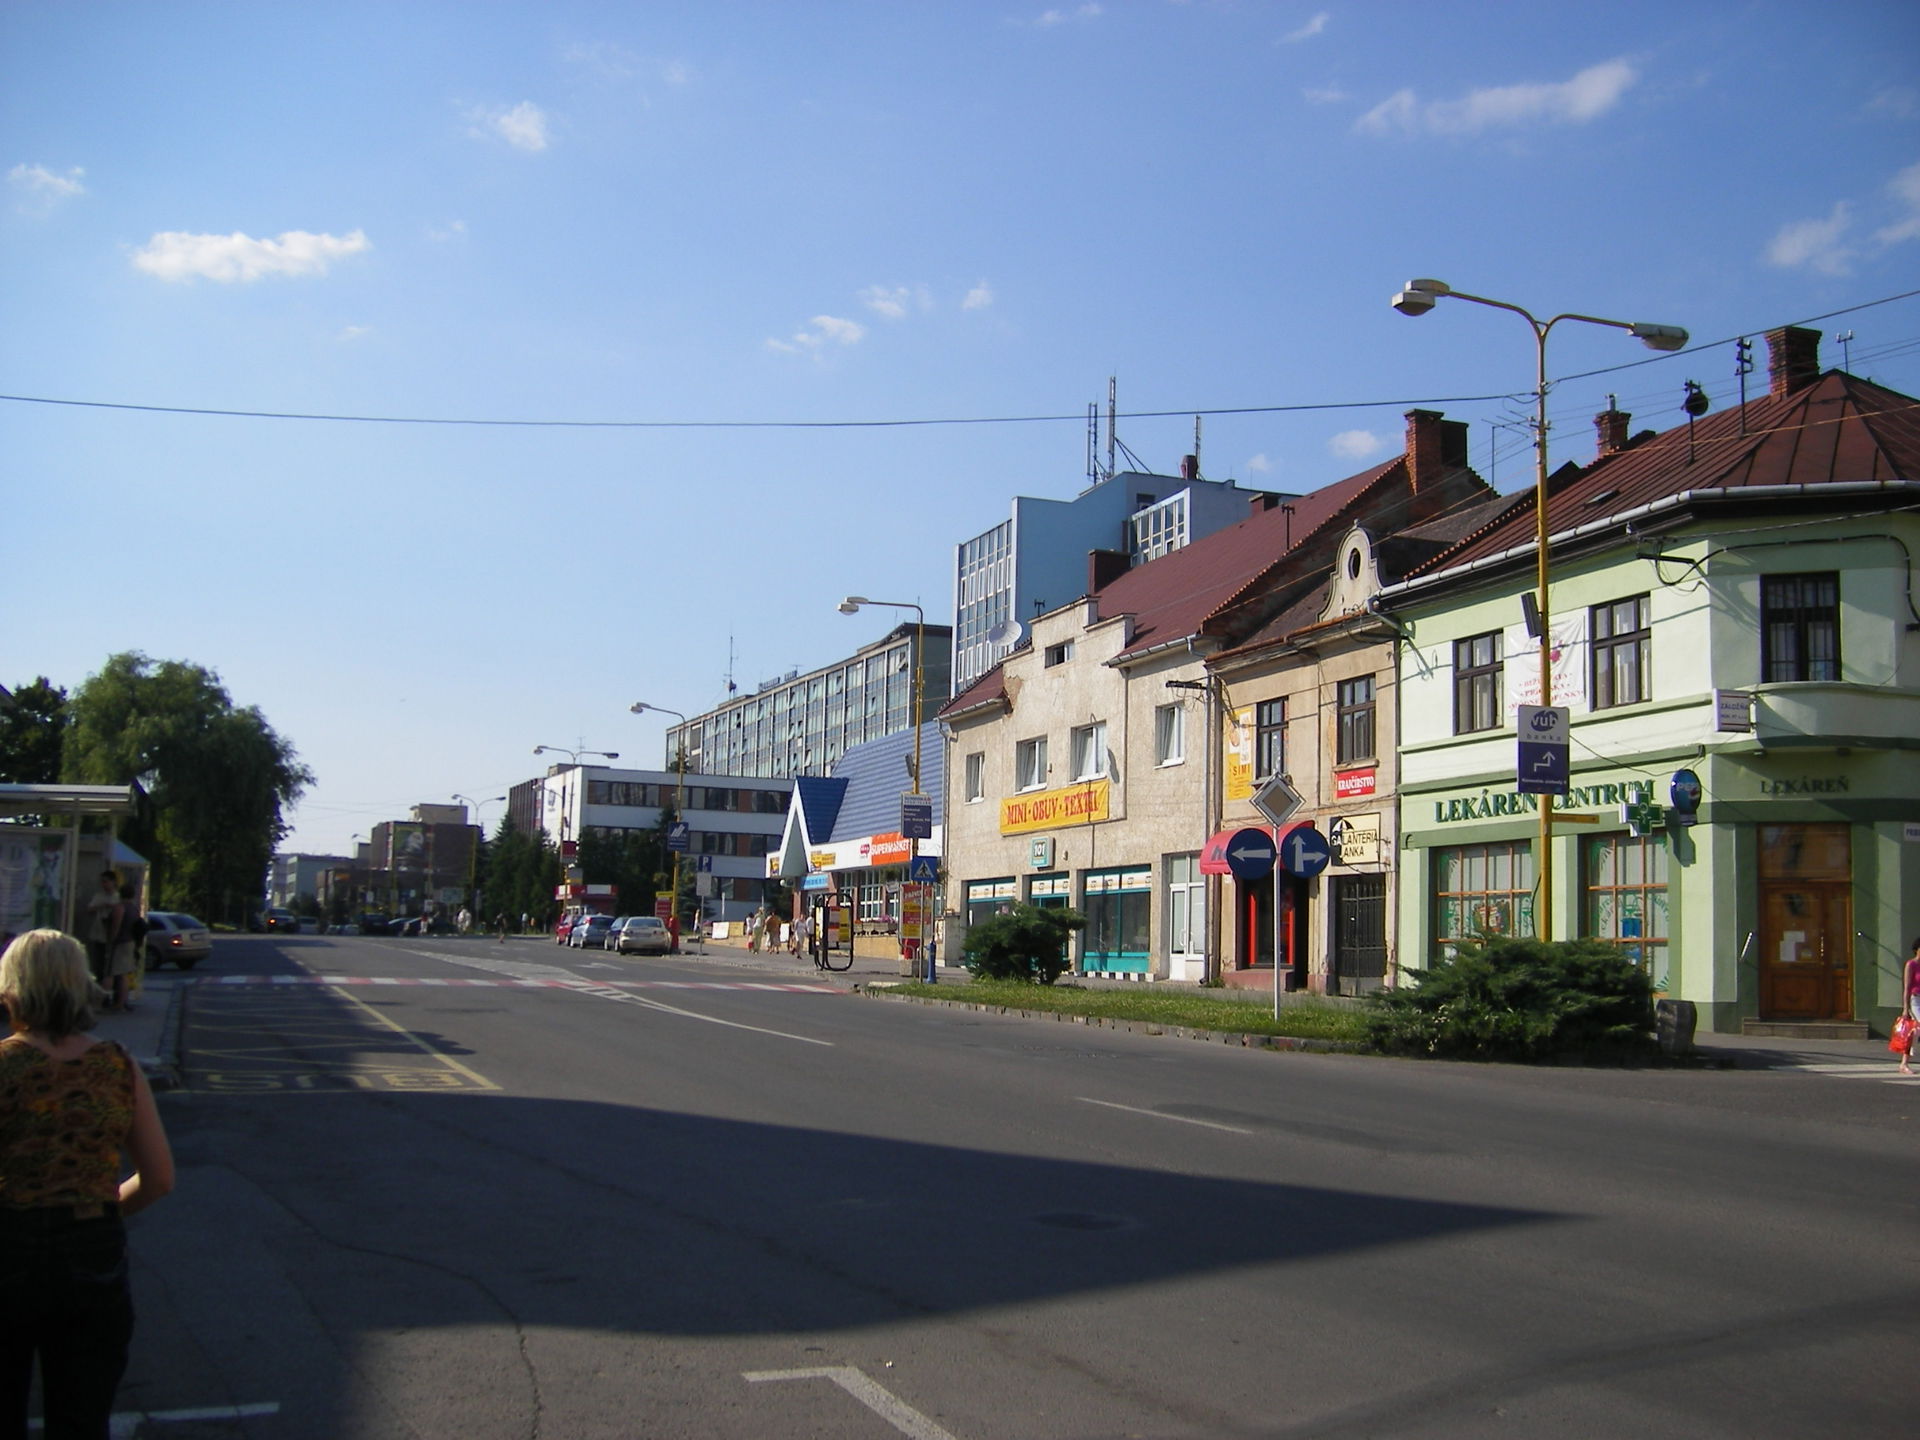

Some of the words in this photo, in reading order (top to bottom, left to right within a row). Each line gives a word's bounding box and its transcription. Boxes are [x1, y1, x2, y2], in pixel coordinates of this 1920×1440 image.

[1760, 775, 1849, 793] LEKÁREŇ
[1007, 802, 1027, 825] MINI
[1032, 797, 1058, 821] OBUV
[871, 840, 911, 856] SUPERMARKET
